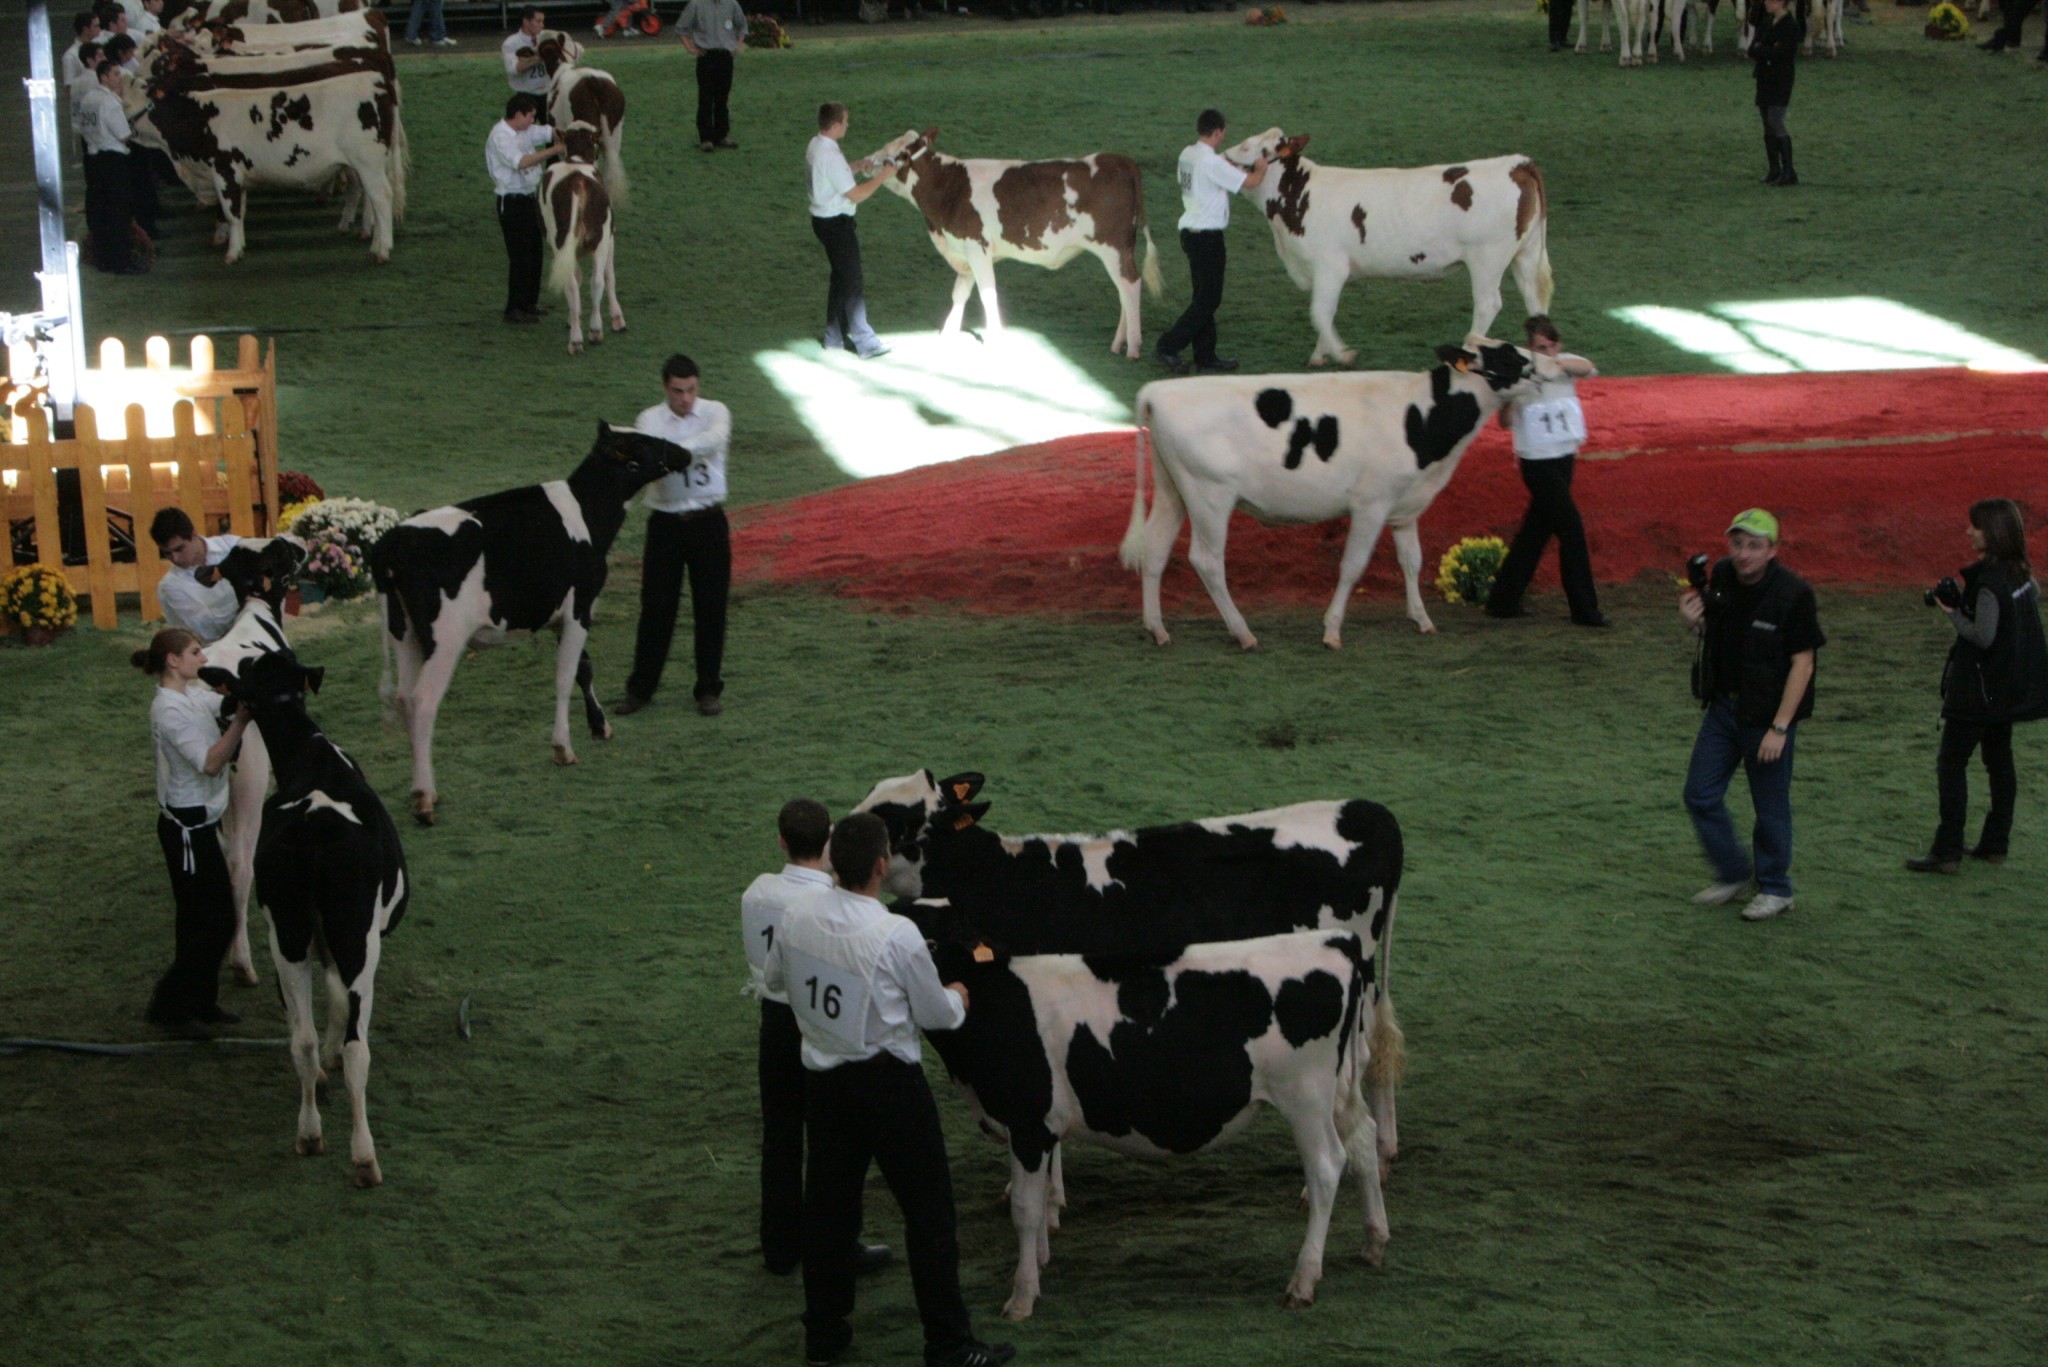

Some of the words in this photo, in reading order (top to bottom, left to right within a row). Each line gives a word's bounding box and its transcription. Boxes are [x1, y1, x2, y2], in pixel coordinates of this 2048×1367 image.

[1539, 411, 1568, 434] 11
[682, 462, 711, 488] 13
[805, 975, 843, 1020] 16
